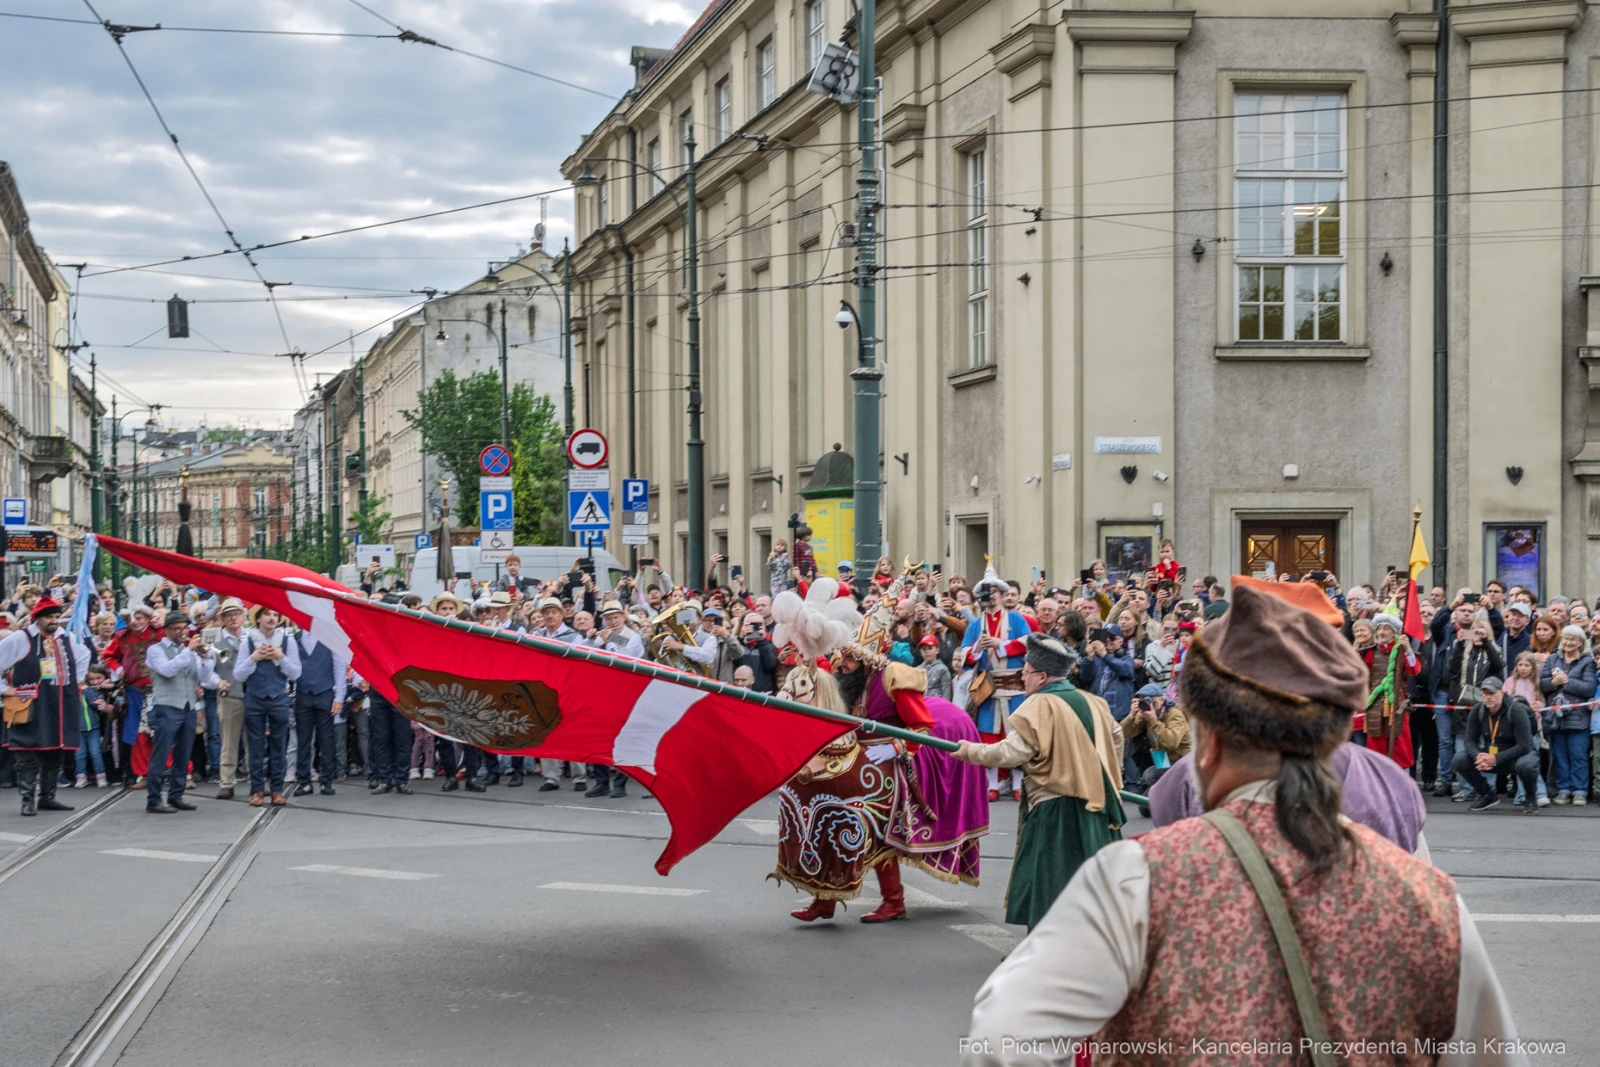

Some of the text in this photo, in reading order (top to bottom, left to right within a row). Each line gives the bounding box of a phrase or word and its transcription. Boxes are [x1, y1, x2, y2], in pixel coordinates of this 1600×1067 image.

[1100, 444, 1158, 453] STRASZEWSKIEGO
[628, 481, 644, 502] P
[487, 494, 507, 519] P
[417, 536, 428, 548] P
